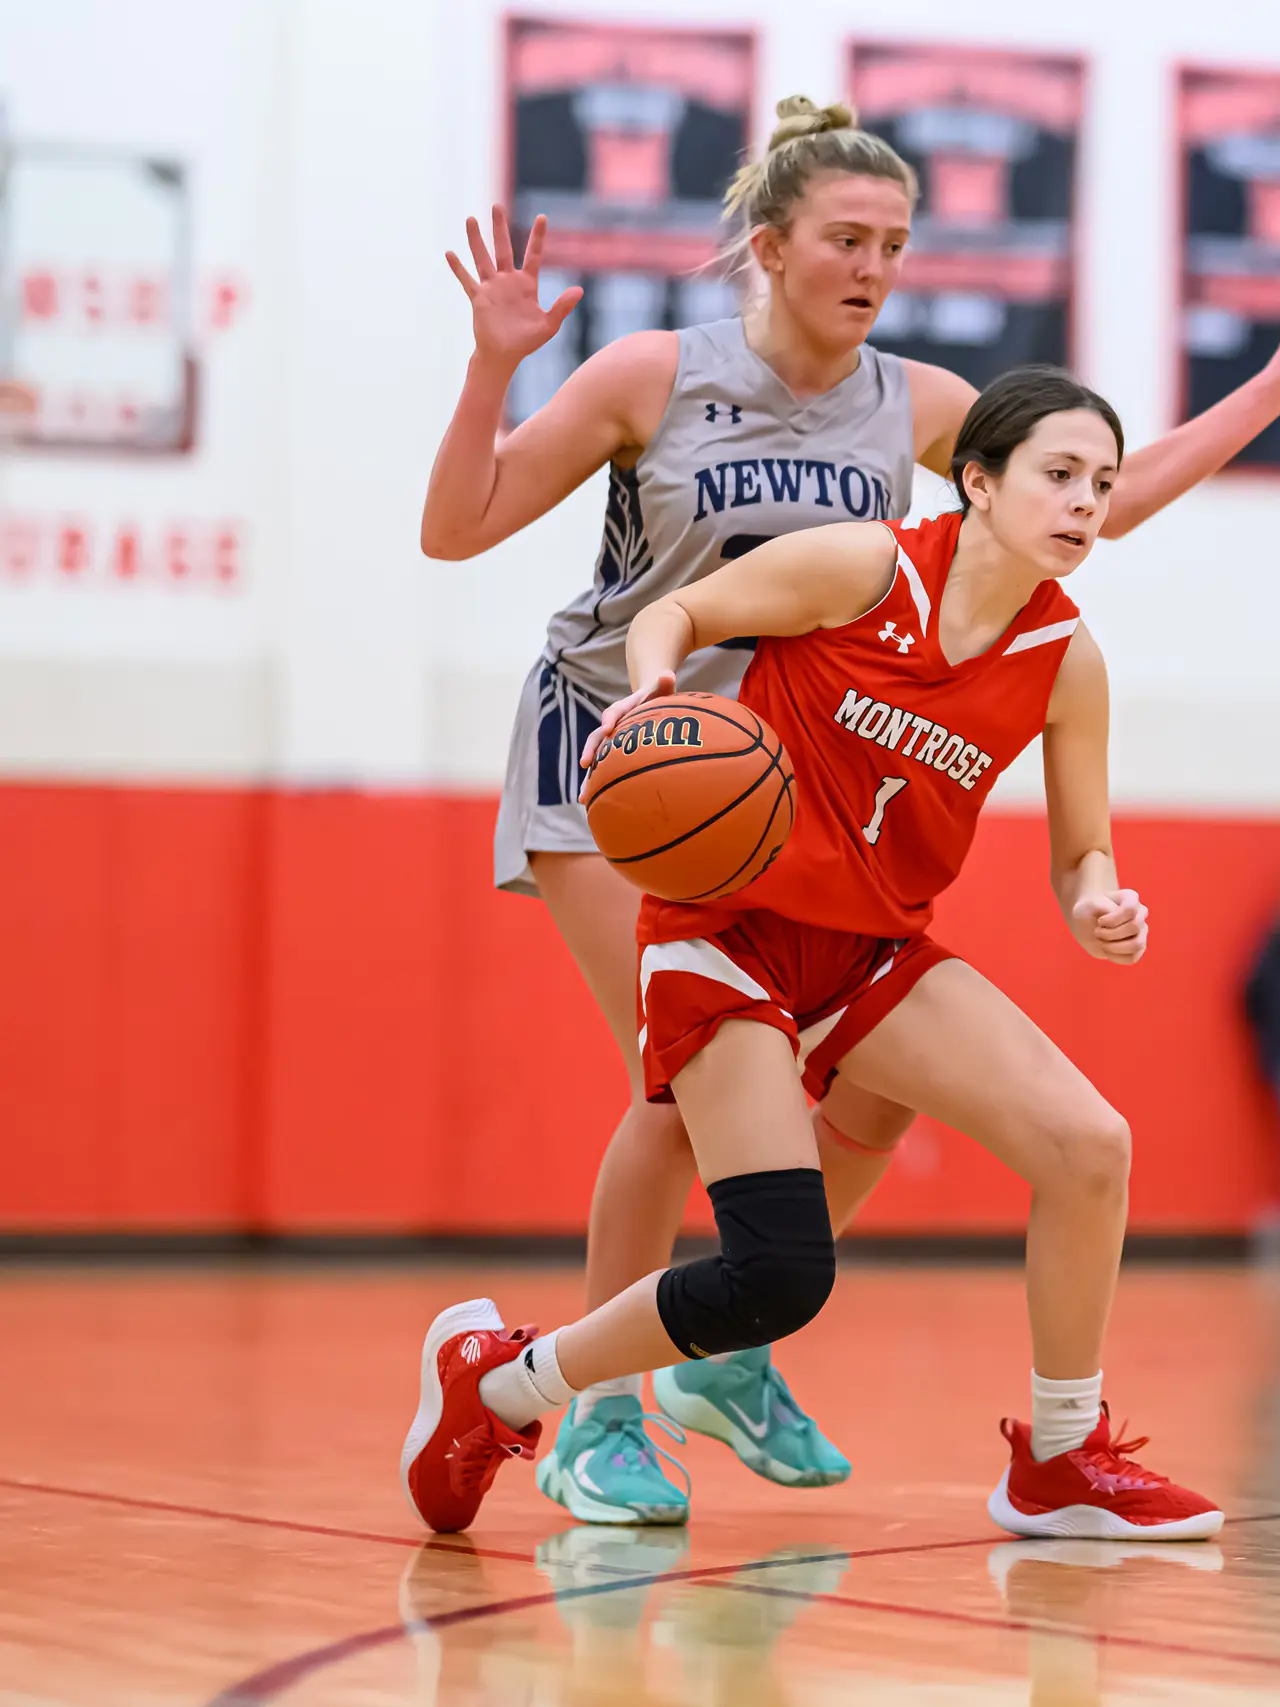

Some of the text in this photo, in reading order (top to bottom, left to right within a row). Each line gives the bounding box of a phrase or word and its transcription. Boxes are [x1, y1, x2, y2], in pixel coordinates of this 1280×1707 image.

[693, 458, 891, 523] NEWTON
[834, 687, 994, 792] MONTROSE
[861, 776, 910, 846] 1
